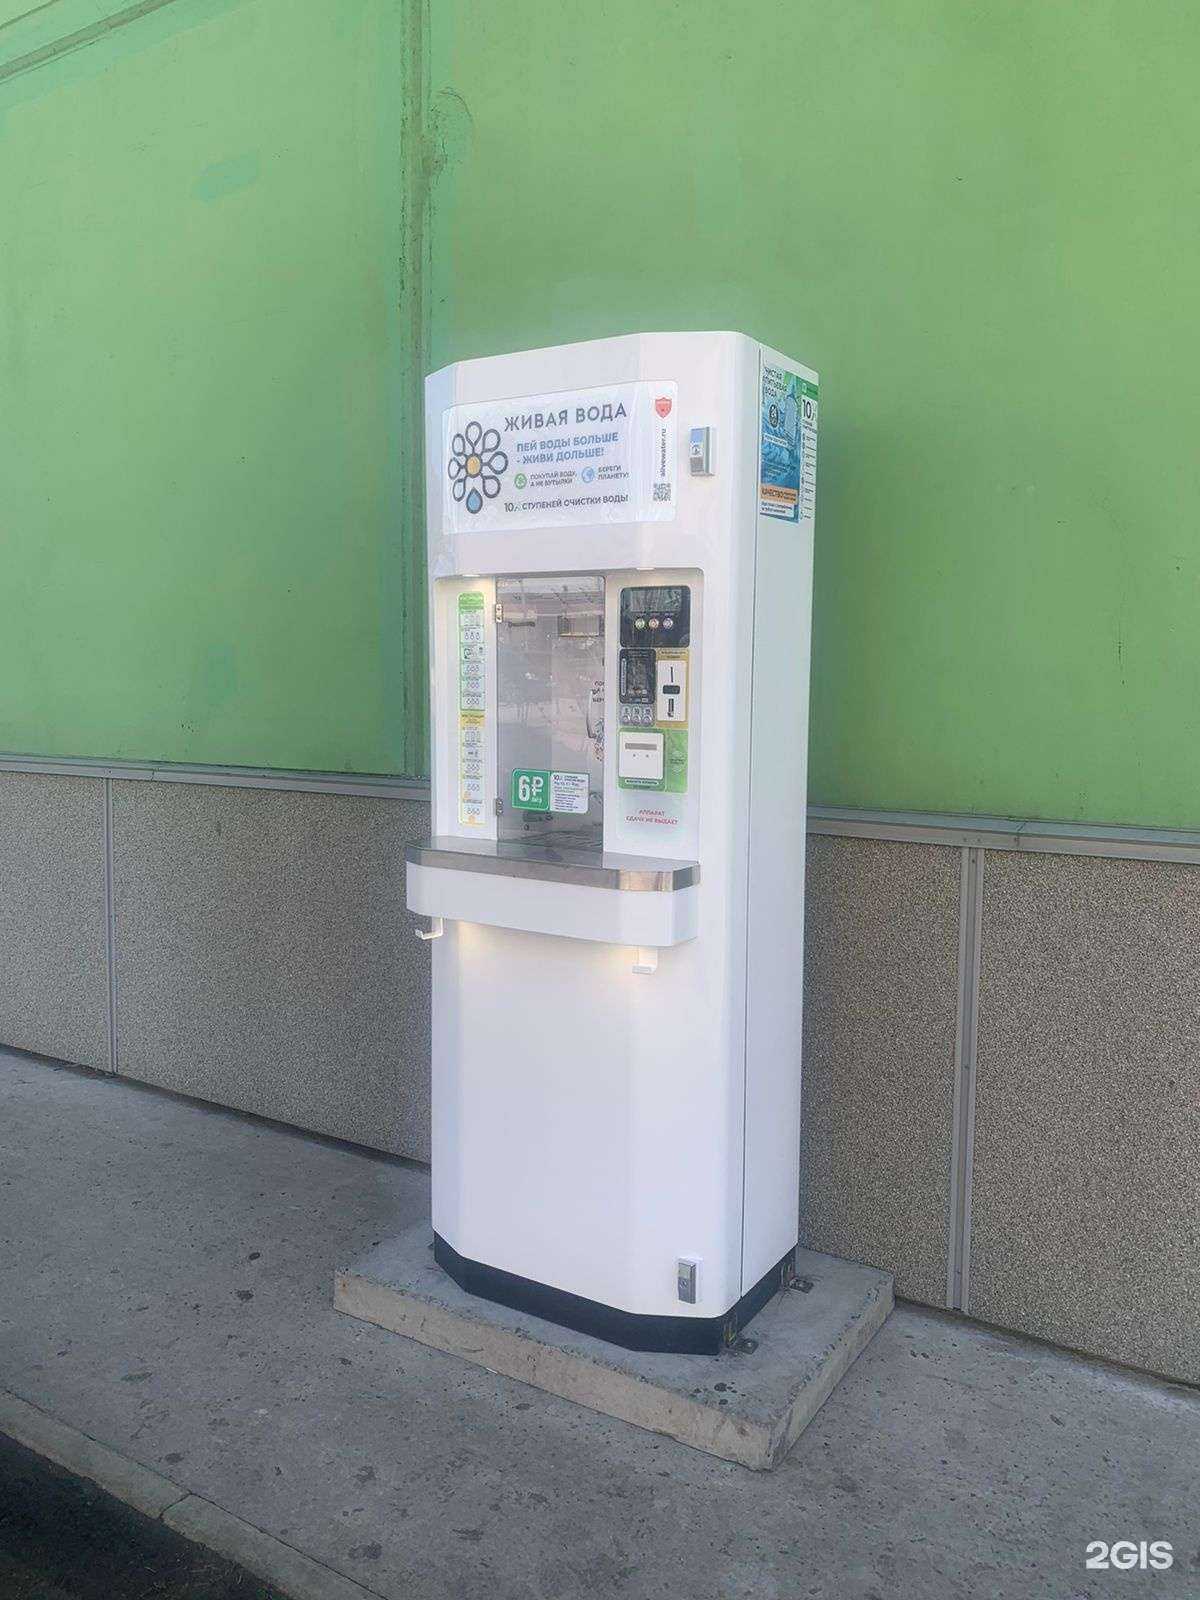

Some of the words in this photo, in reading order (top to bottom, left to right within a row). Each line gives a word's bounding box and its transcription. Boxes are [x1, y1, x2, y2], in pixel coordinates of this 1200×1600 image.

[504, 409, 568, 432] ЖИВАЯ
[575, 402, 627, 424] ВОДА
[517, 440, 538, 453] ПЕЙ
[540, 437, 571, 450] ВОДЫ
[573, 431, 619, 447] БОЛЬШЕ
[522, 452, 554, 465] ЖИВИ
[556, 446, 605, 462] ДОЛЬШЕ!
[522, 499, 563, 510] СТУПЕНЕЙ
[563, 496, 601, 507] ОЧИСТКИ
